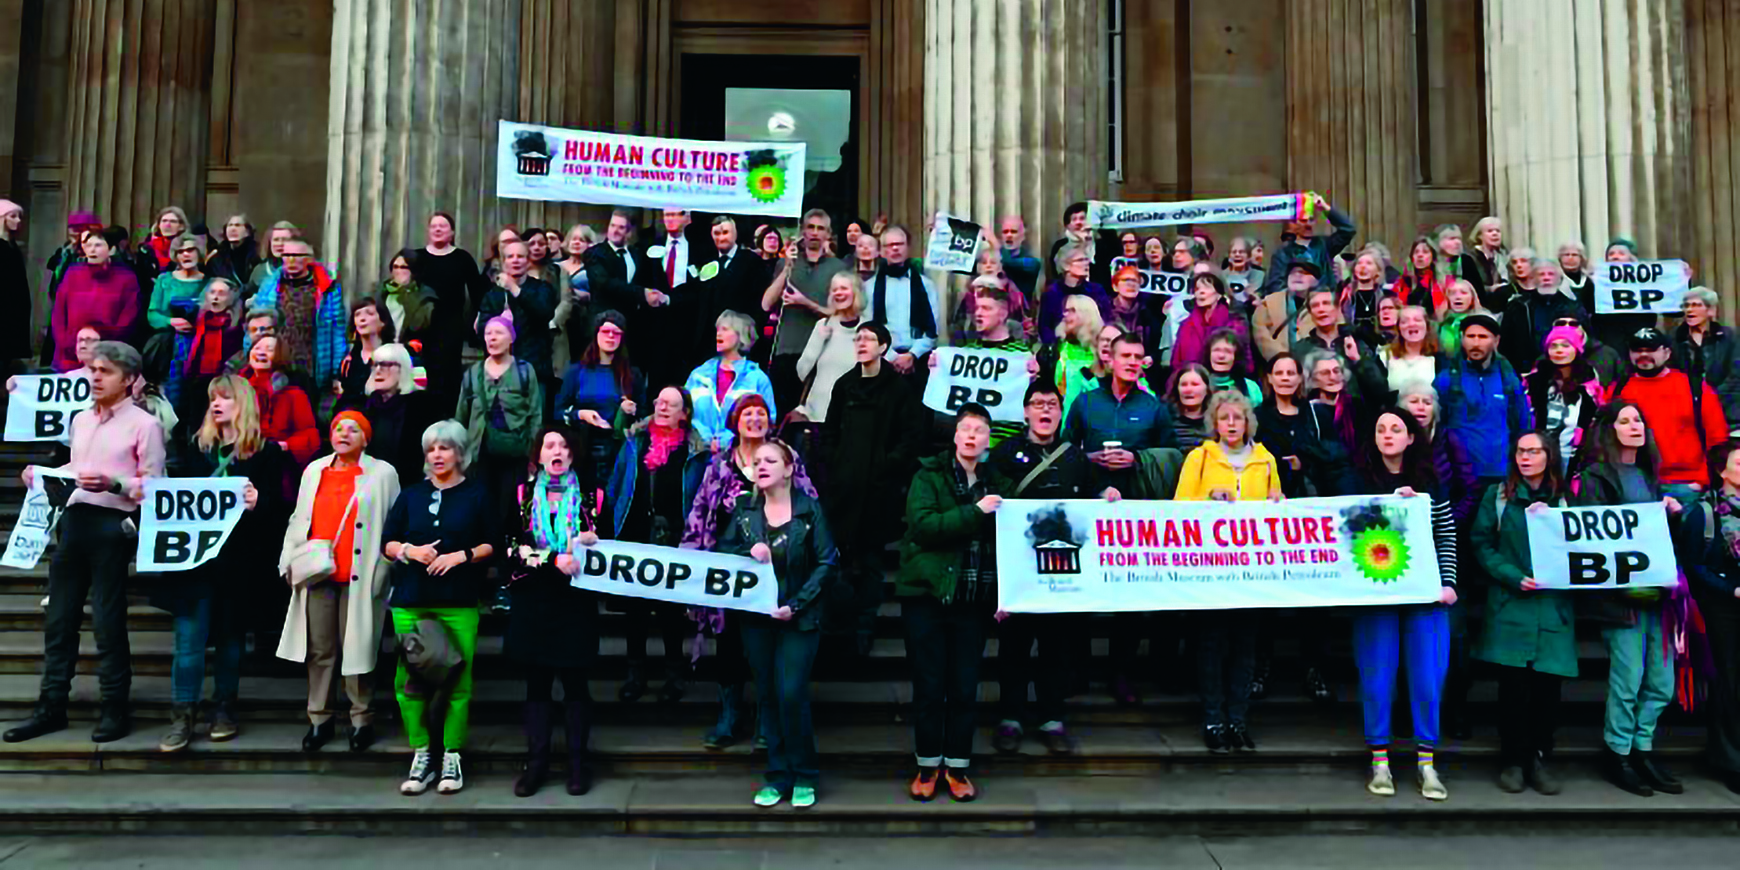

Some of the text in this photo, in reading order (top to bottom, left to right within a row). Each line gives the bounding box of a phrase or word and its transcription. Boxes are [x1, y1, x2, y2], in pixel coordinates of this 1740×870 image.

[564, 140, 740, 172] HUMAN CULTURE
[563, 163, 592, 175] FROM
[680, 171, 693, 183] TO
[954, 233, 973, 249] bp
[1609, 264, 1663, 283] DROP
[1611, 289, 1664, 310] BP
[951, 354, 1009, 382] DROP
[38, 378, 90, 402] DRO
[946, 385, 1002, 410] BP
[35, 409, 82, 437] B
[155, 490, 237, 520] DROP
[1096, 516, 1337, 548] HUMAN CULTURE
[1562, 509, 1639, 542] DROP
[153, 531, 223, 563] BP
[1100, 548, 1338, 566] FROM THE BEGINNING TO THE END
[583, 549, 758, 598] DROP BP
[1568, 551, 1650, 585] BP
